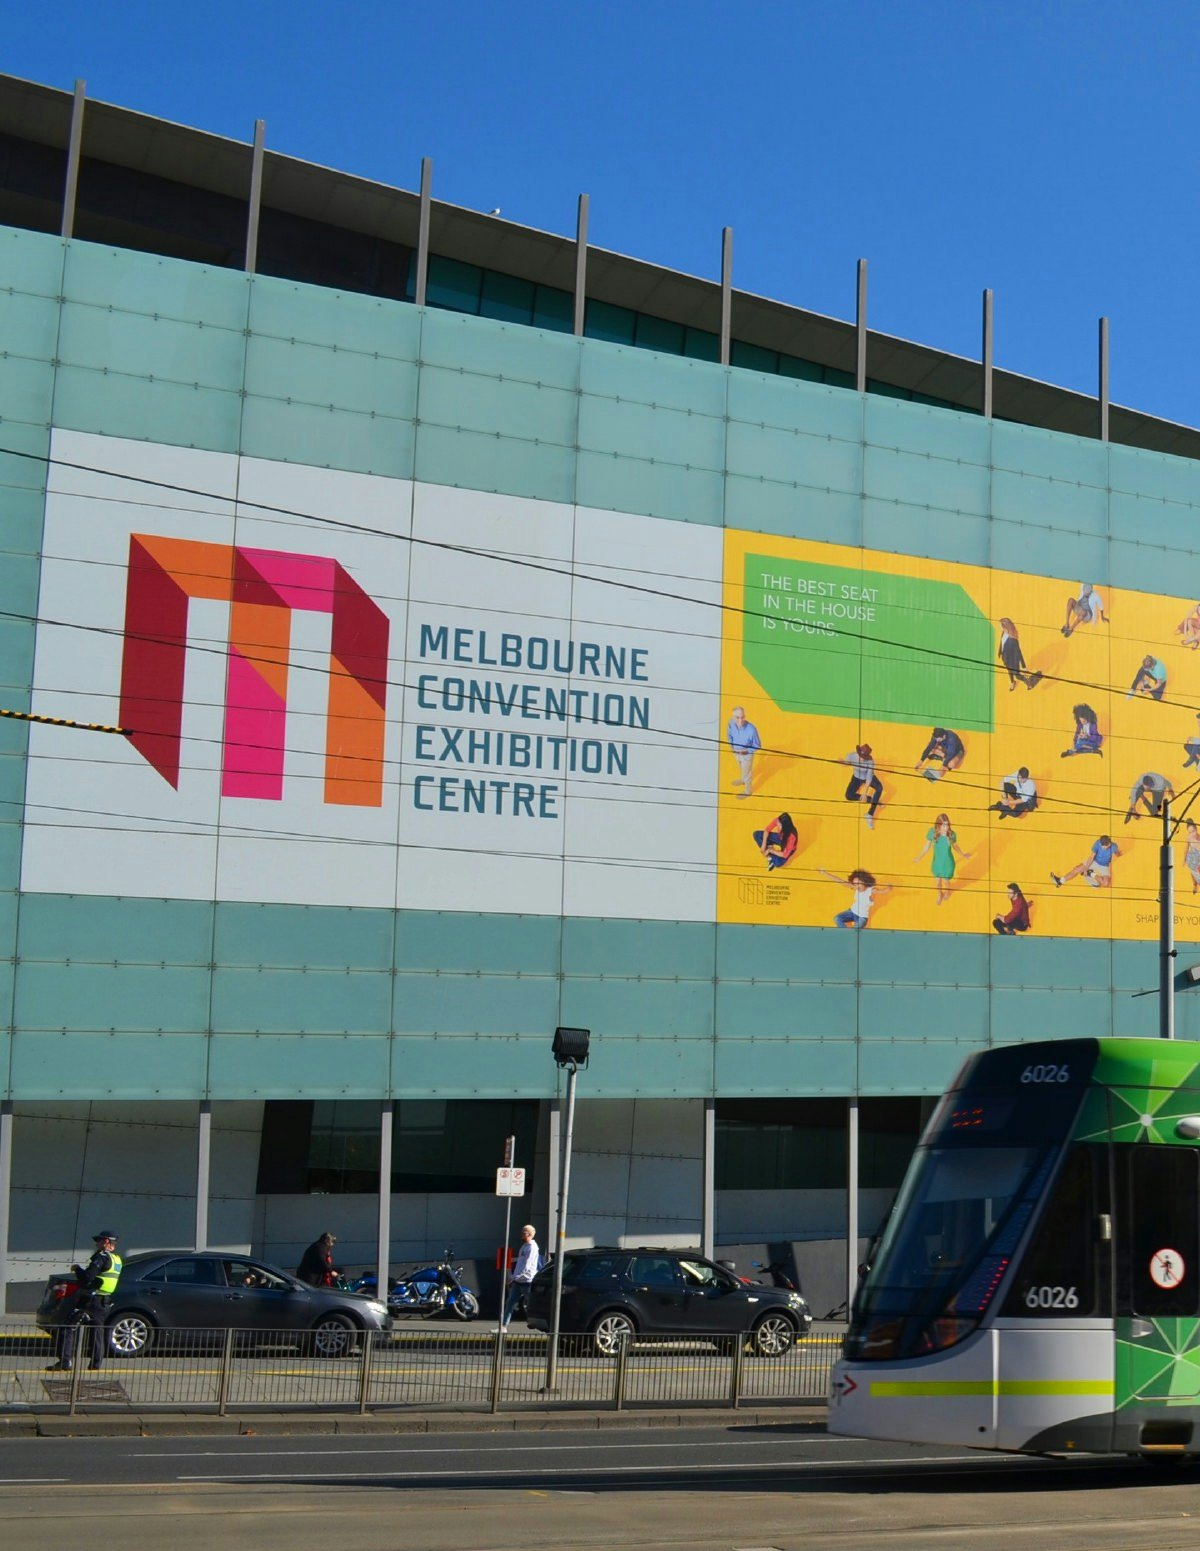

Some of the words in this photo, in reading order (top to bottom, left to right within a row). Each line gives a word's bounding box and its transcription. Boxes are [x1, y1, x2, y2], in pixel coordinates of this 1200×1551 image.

[761, 573, 792, 591] THE
[797, 579, 836, 597] BEST
[841, 585, 879, 602] SEAT
[763, 594, 779, 610] IN
[786, 597, 816, 614] THE
[821, 603, 876, 622] HOUSE
[763, 615, 776, 630] IS
[782, 618, 839, 637] YOURS.
[419, 624, 649, 681] MELBOURNE
[417, 675, 650, 729] CONVENTION
[415, 725, 628, 775] EXHIBITION
[413, 775, 559, 818] CENTRE
[1174, 915, 1183, 925] BY
[1020, 1065, 1070, 1083] 6026
[1026, 1287, 1079, 1308] 6026
